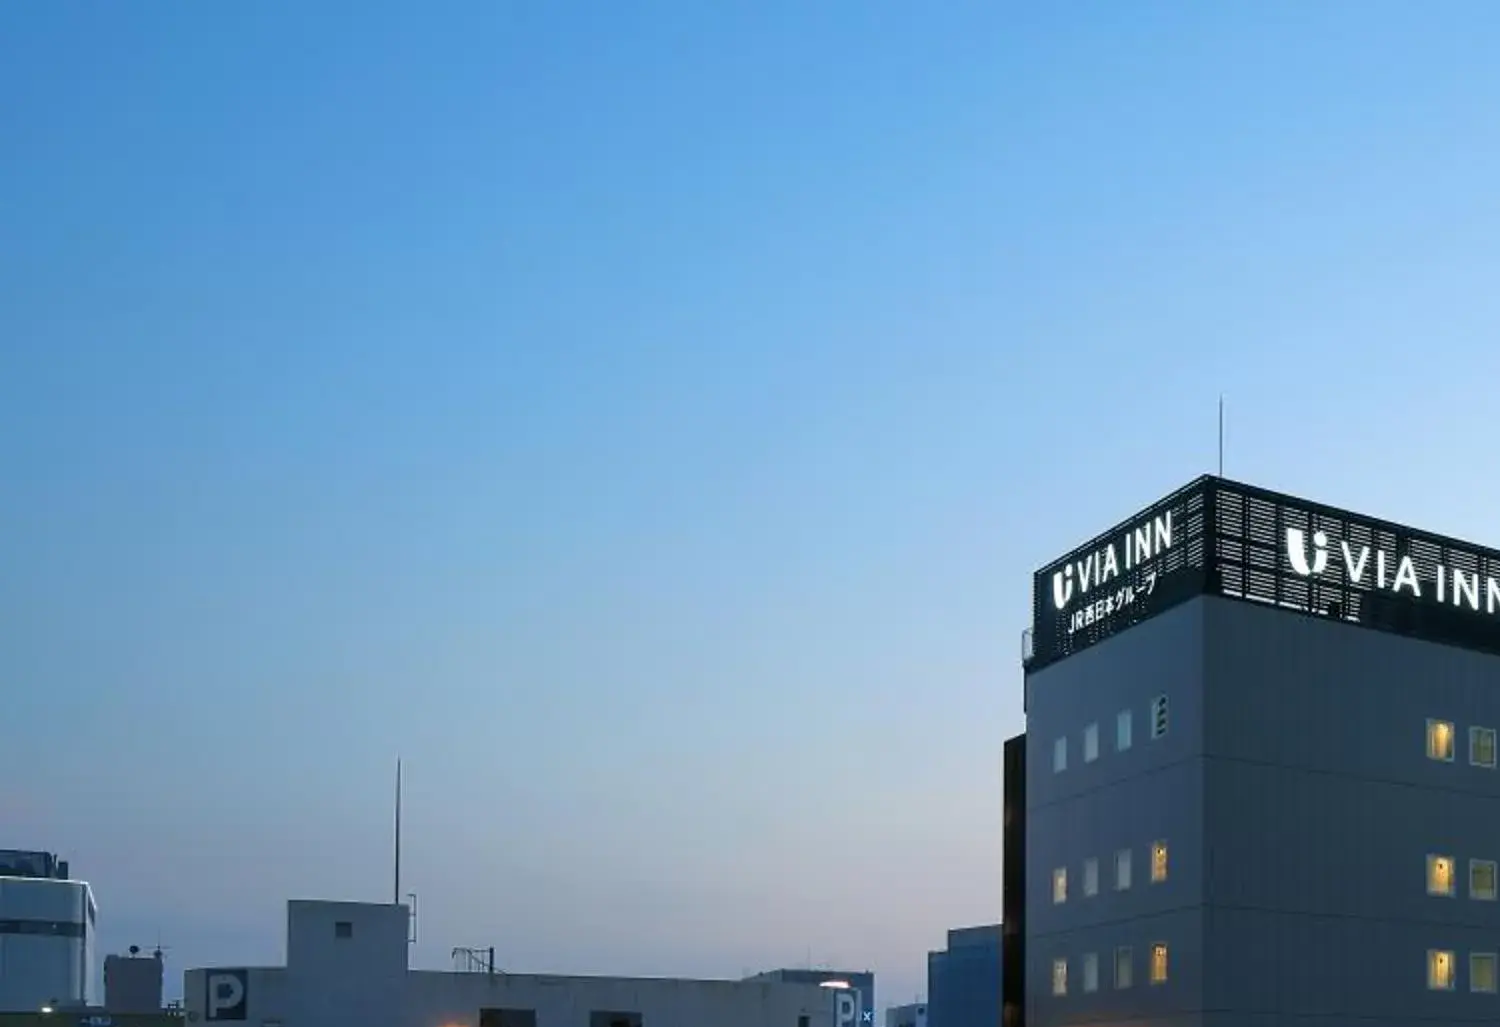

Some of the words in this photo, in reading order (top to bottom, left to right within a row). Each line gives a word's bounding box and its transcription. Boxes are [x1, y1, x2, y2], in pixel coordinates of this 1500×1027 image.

[1077, 543, 1119, 593] VIA
[1126, 510, 1171, 570] INN
[1341, 540, 1421, 597] VIA
[209, 974, 243, 1018] P
